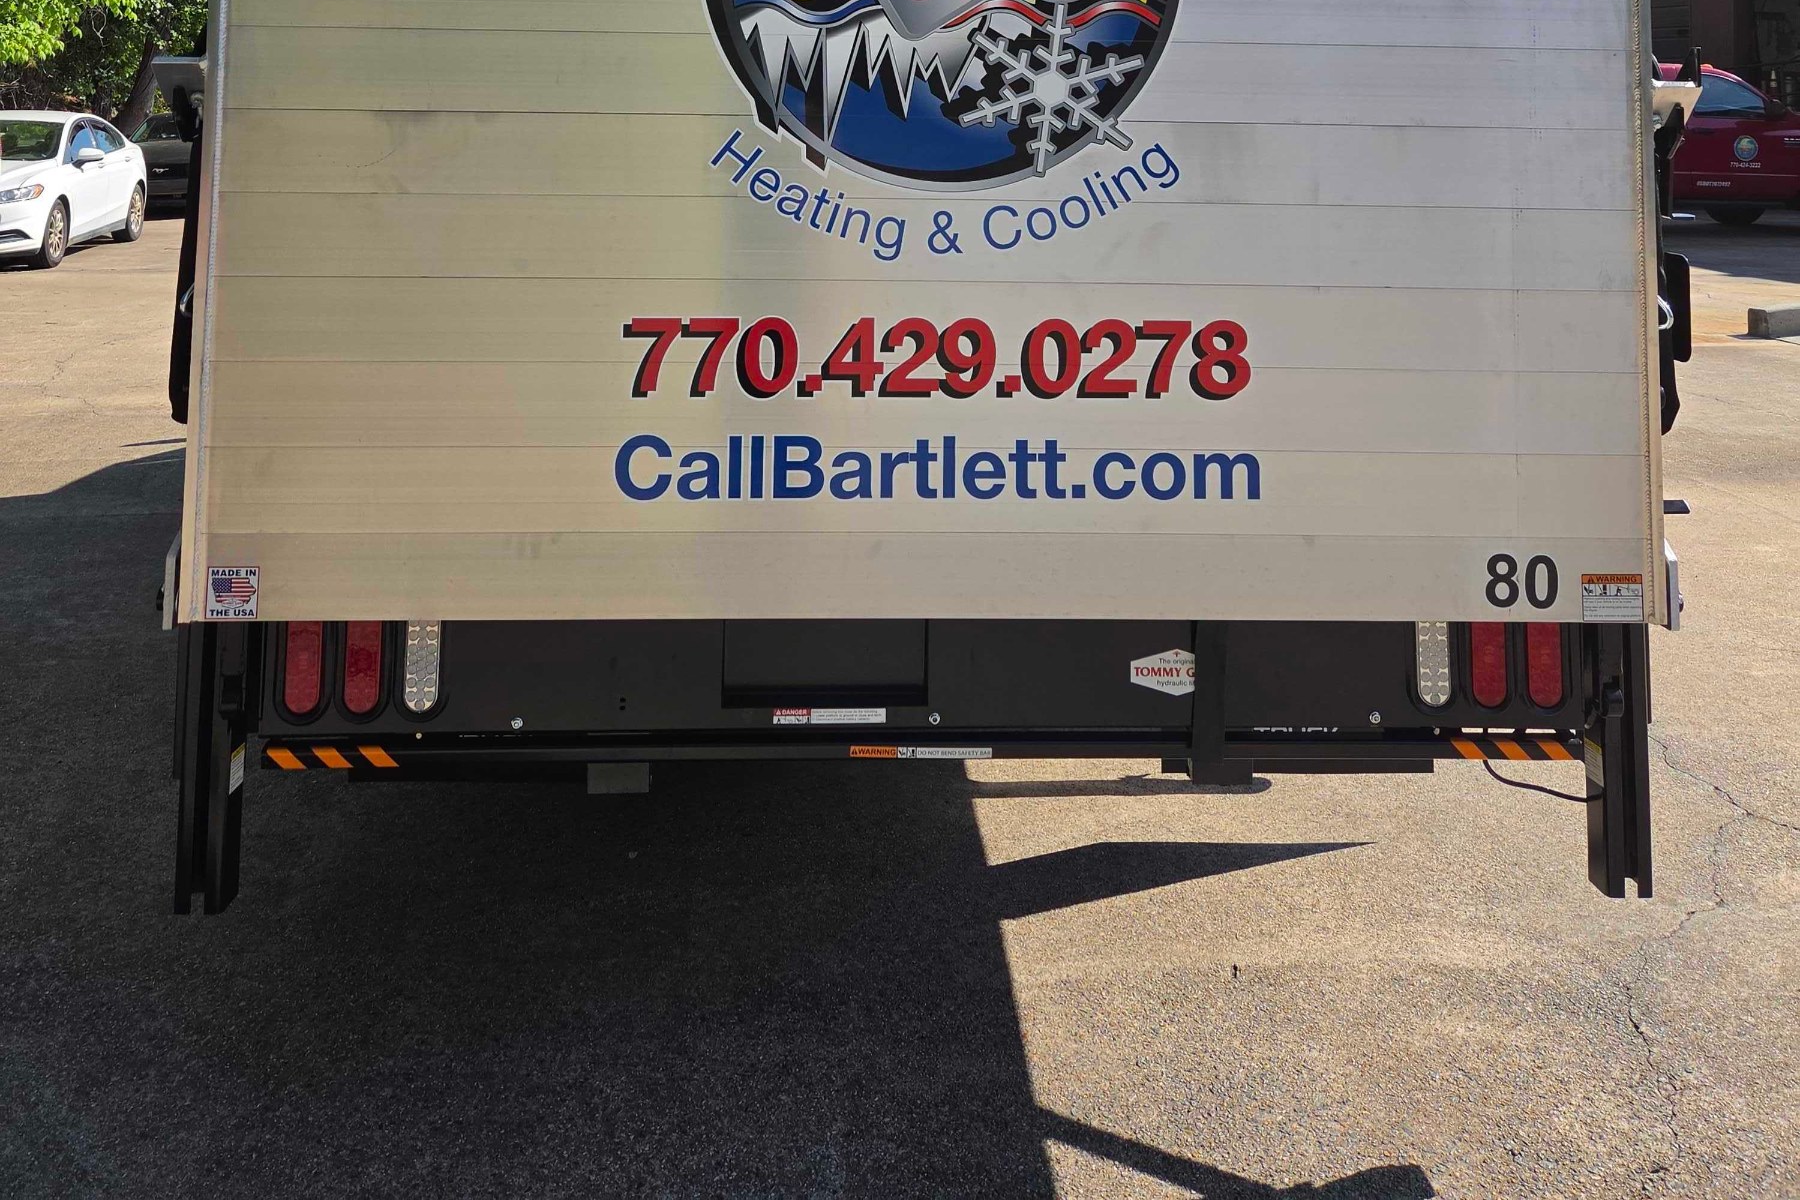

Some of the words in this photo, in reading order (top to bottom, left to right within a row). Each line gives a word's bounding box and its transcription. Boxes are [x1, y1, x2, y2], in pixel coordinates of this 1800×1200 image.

[709, 129, 908, 262] Heating
[926, 210, 964, 255] &
[983, 141, 1181, 250] Cooling
[622, 316, 1252, 400] 770.429.0278
[613, 434, 1262, 501] CallBartlett.com
[211, 569, 242, 577] MADE
[245, 569, 257, 577] IN
[1485, 553, 1559, 610] 80
[1595, 575, 1638, 583] WARNING
[210, 609, 231, 617] THE
[233, 609, 255, 617] USA
[1159, 657, 1171, 665] The
[1172, 657, 1195, 666] origina
[1134, 666, 1181, 678] TOMMY
[1186, 667, 1196, 678] G
[1156, 679, 1187, 687] hydraulic
[782, 708, 808, 716] DANGER
[858, 747, 897, 756] WARNING
